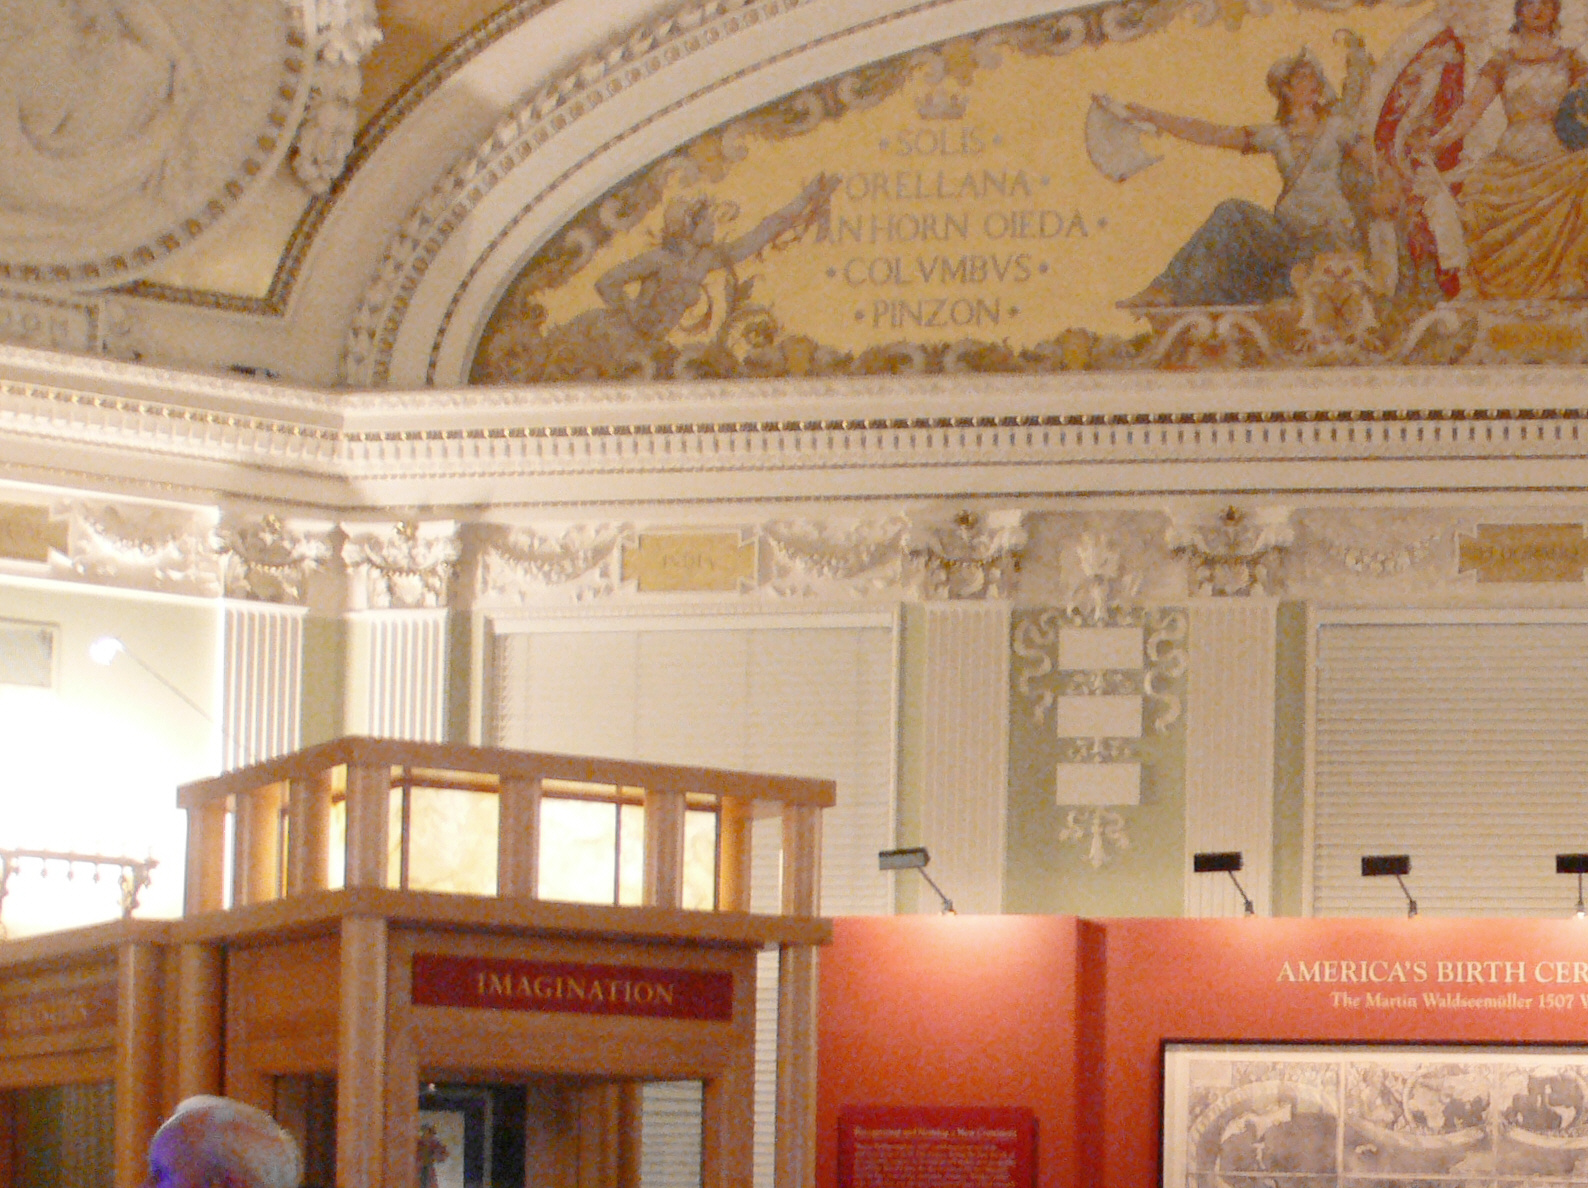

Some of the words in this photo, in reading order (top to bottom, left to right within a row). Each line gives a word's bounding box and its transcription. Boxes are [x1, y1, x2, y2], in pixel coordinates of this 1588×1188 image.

[896, 126, 986, 156] SOLIS
[844, 168, 1033, 201] ORELLANA
[843, 252, 1032, 288] COLVMBVS
[872, 298, 1001, 329] PINZON
[1276, 960, 1428, 984] AMERICA'S
[1436, 960, 1527, 984] BIRTH
[477, 970, 674, 1006] IMAGINATION
[1331, 990, 1361, 1008] The
[1366, 991, 1418, 1009] Martin
[1539, 992, 1574, 1009] 1507
